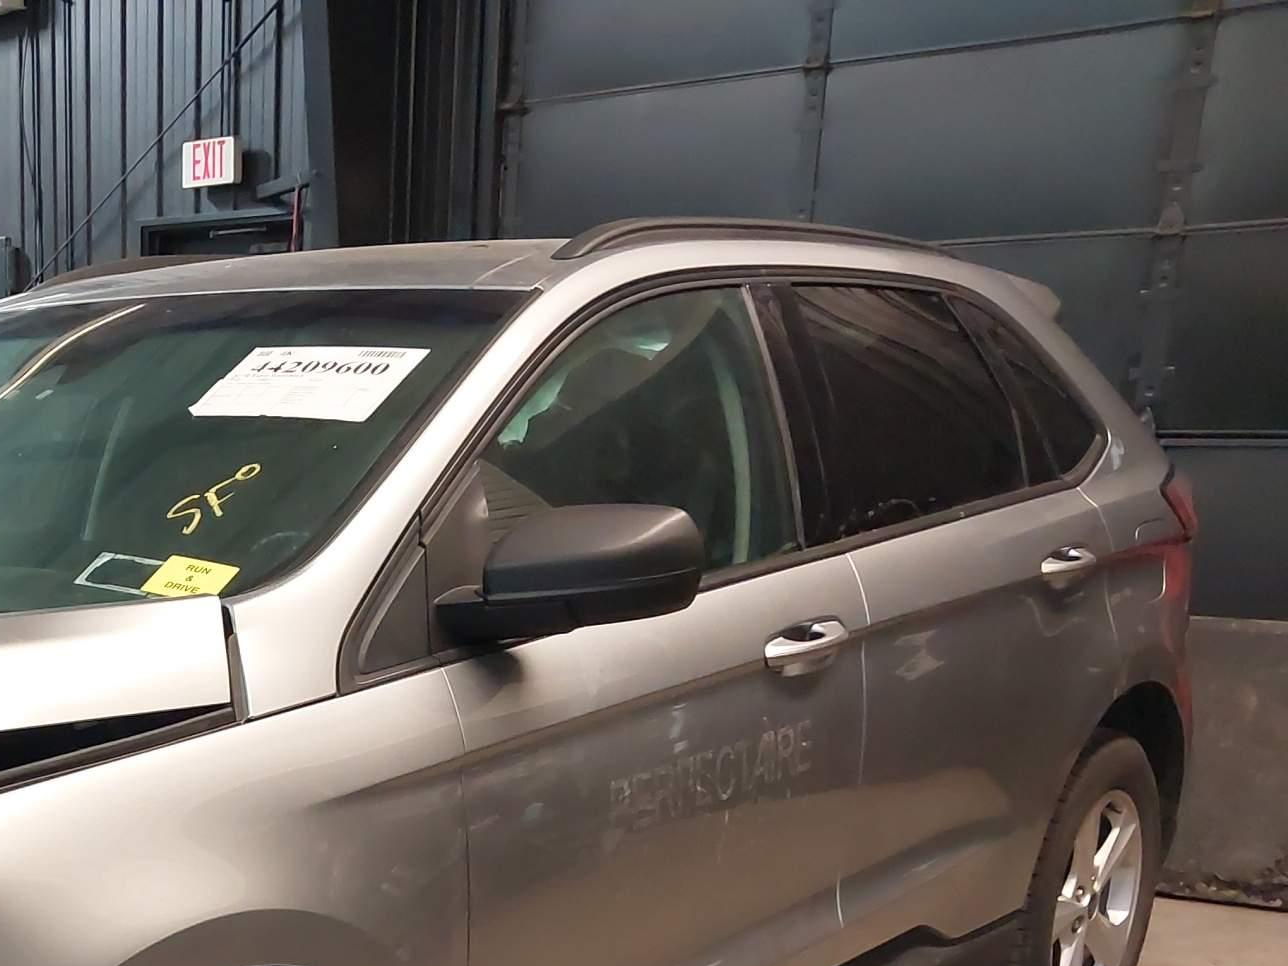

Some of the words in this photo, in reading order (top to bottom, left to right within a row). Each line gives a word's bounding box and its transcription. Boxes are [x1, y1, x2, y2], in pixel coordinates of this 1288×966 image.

[192, 140, 225, 181] EXIT
[250, 360, 390, 375] 44209600
[185, 564, 212, 575] RUN
[164, 581, 201, 594] DRIVE
